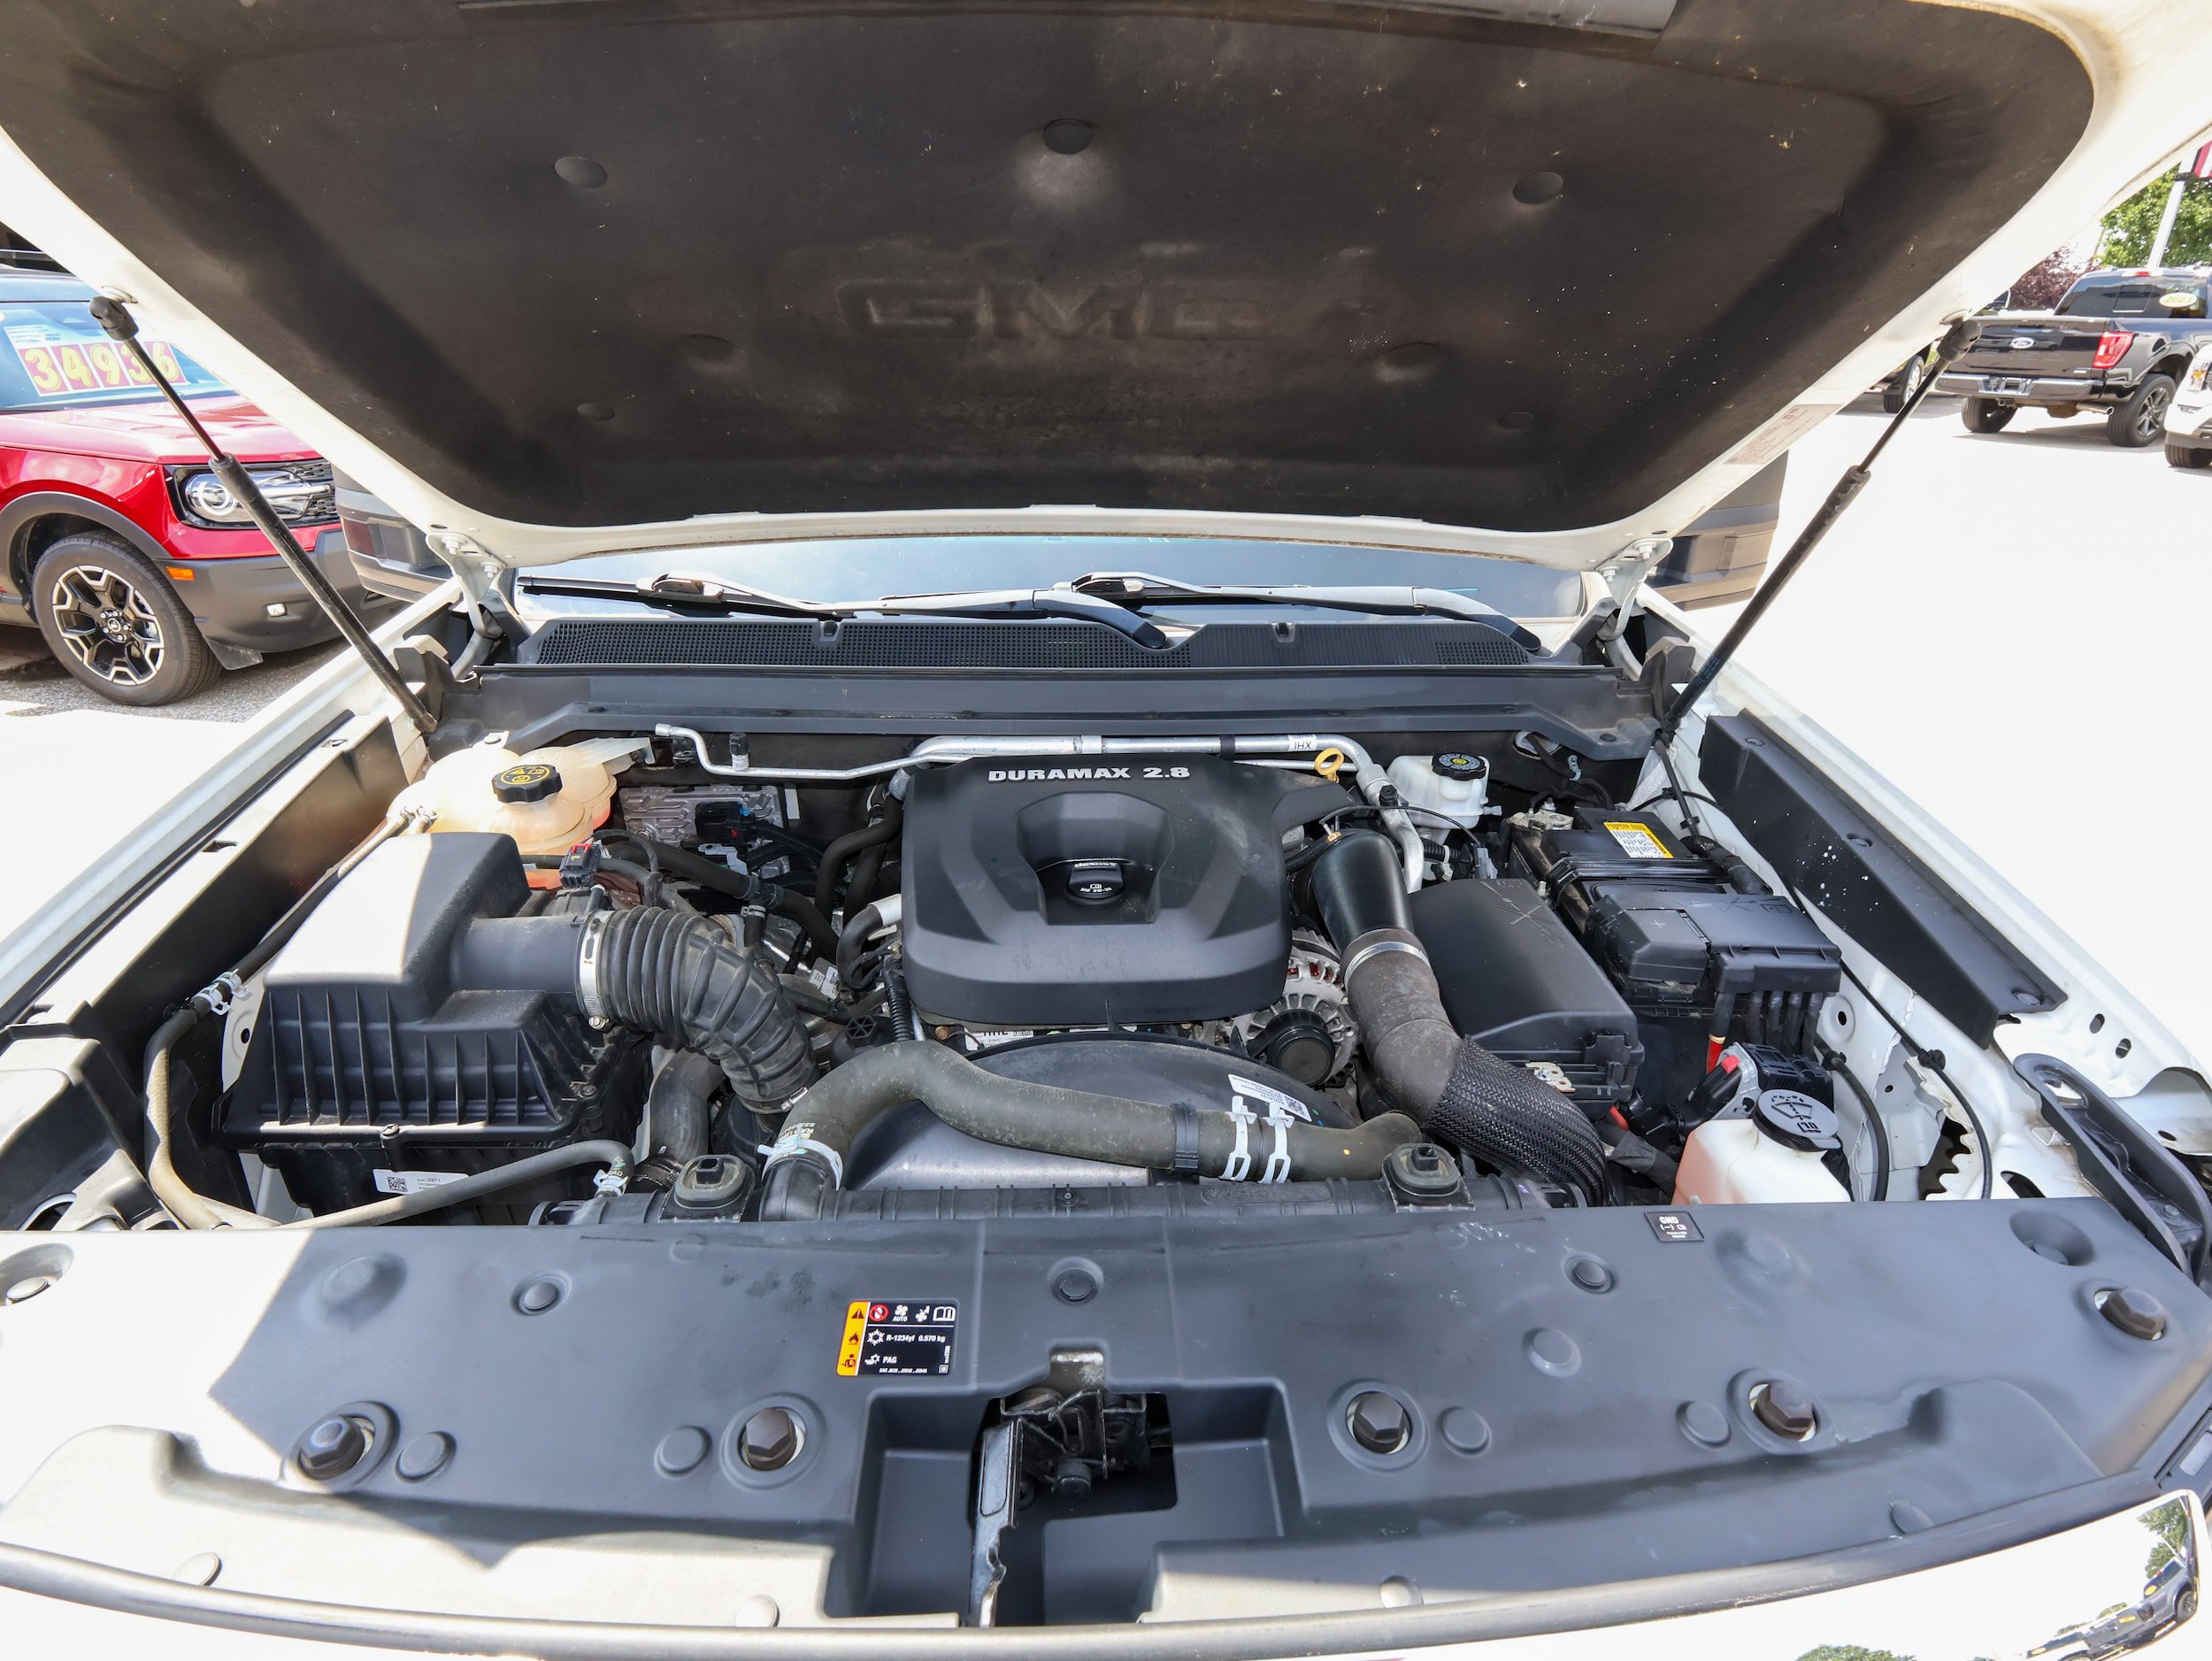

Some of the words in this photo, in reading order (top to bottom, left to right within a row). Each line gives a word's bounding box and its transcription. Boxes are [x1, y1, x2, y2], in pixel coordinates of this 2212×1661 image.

[834, 278, 1283, 342] GMC
[25, 342, 180, 390] 34936
[988, 767, 1132, 781] DURAMAX
[1143, 766, 1190, 778] 2.8
[937, 1334, 946, 1343] kg
